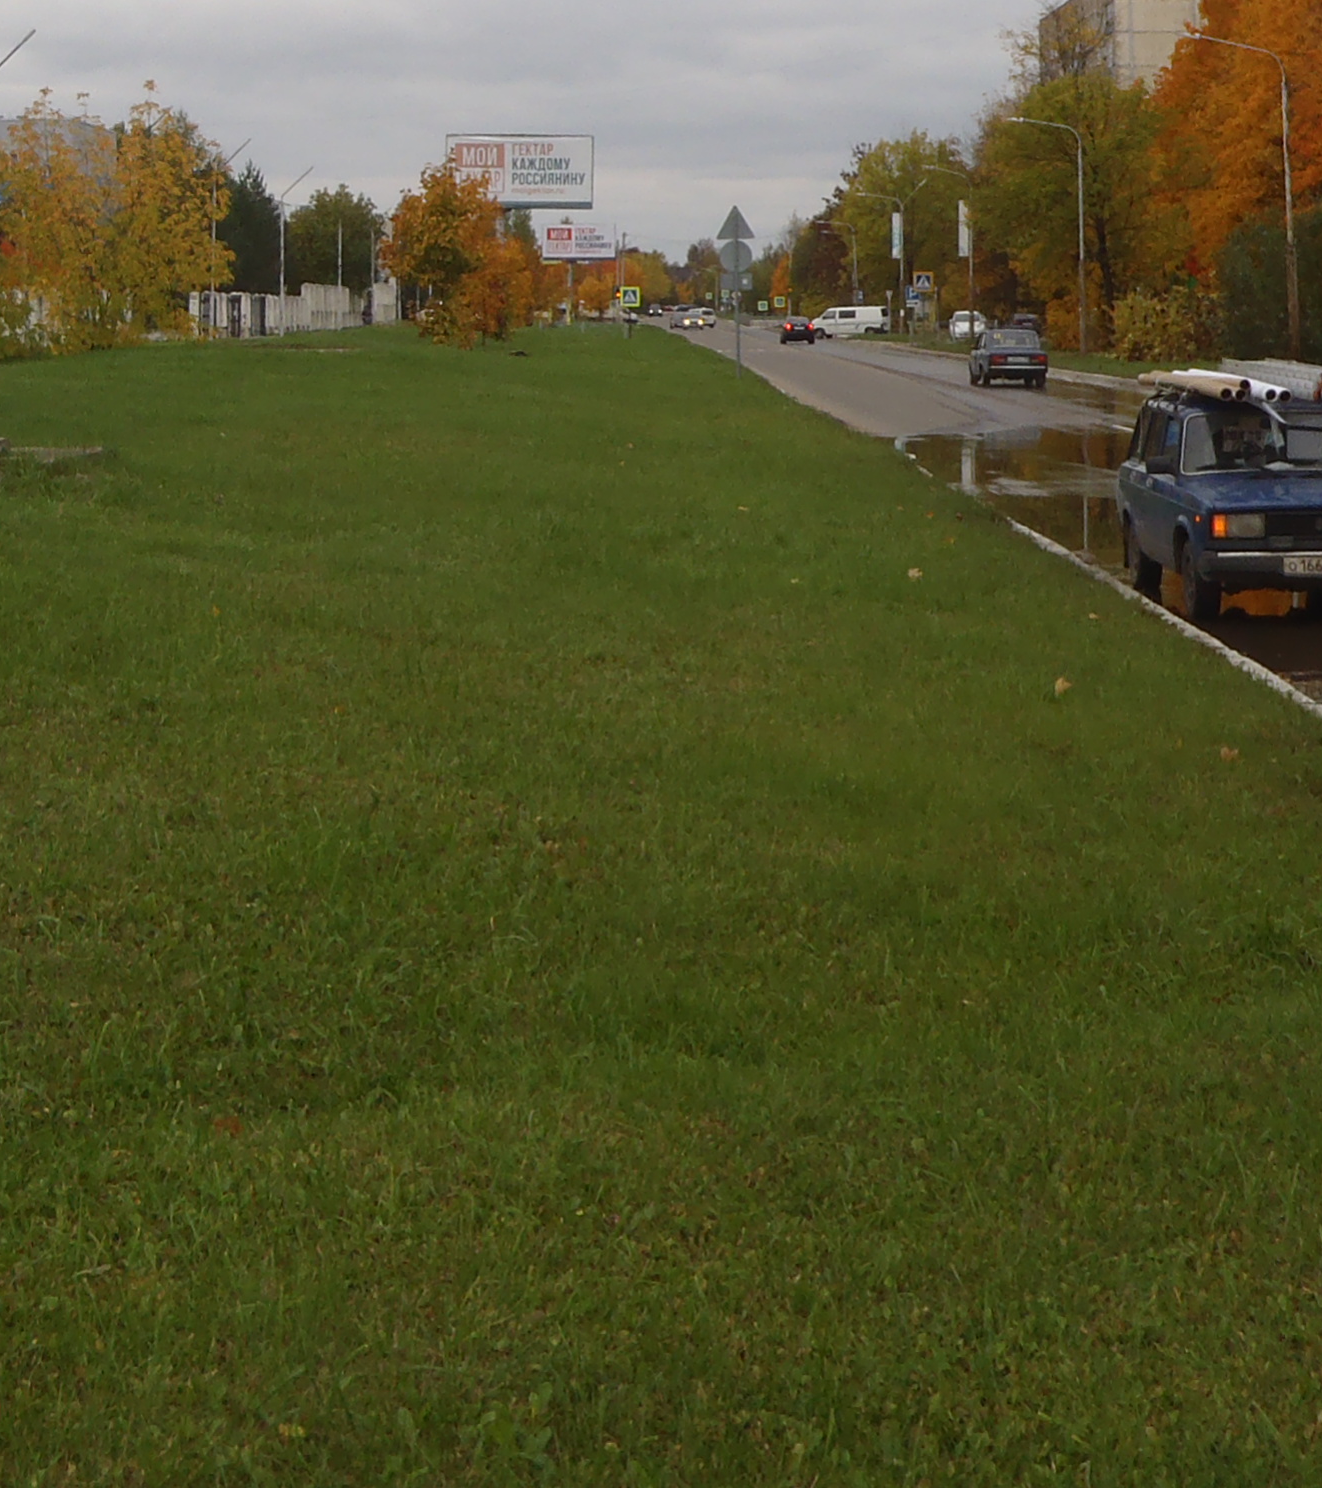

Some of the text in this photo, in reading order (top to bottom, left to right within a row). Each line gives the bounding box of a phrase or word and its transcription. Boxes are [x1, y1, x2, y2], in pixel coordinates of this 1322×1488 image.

[512, 143, 554, 156] ГЕКТАР
[511, 157, 571, 171] КАЖДОМУ
[511, 172, 586, 186] РОССИЯНИНУ
